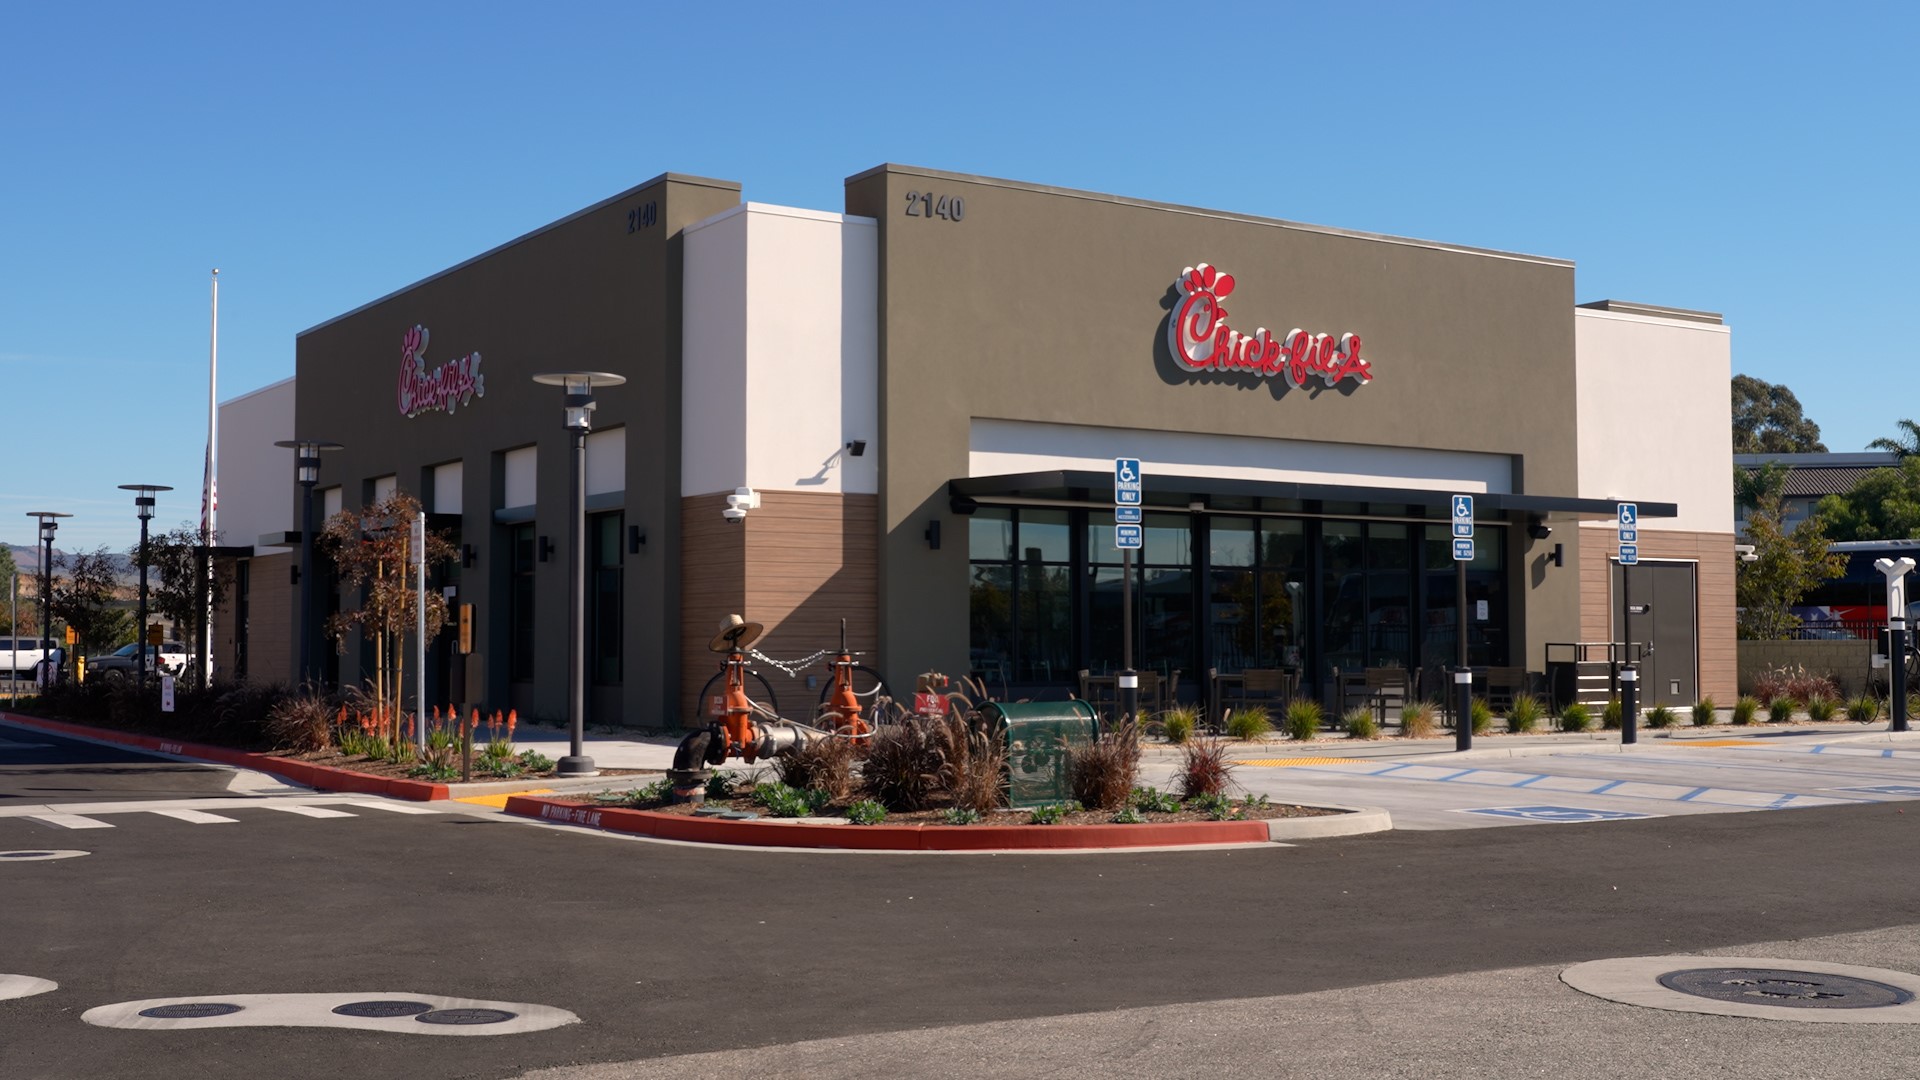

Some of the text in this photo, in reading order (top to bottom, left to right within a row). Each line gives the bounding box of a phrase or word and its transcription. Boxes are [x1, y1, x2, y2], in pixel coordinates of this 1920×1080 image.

[627, 202, 658, 235] 2140
[904, 190, 966, 222] 2140
[1176, 285, 1373, 385] Chick-fil-A
[398, 342, 477, 416] Chick-fil-A
[1118, 481, 1140, 491] PARKING
[1122, 492, 1136, 501] ONLY
[1458, 525, 1469, 534] ONLY
[542, 804, 550, 818] NO
[587, 811, 602, 826] LANE
